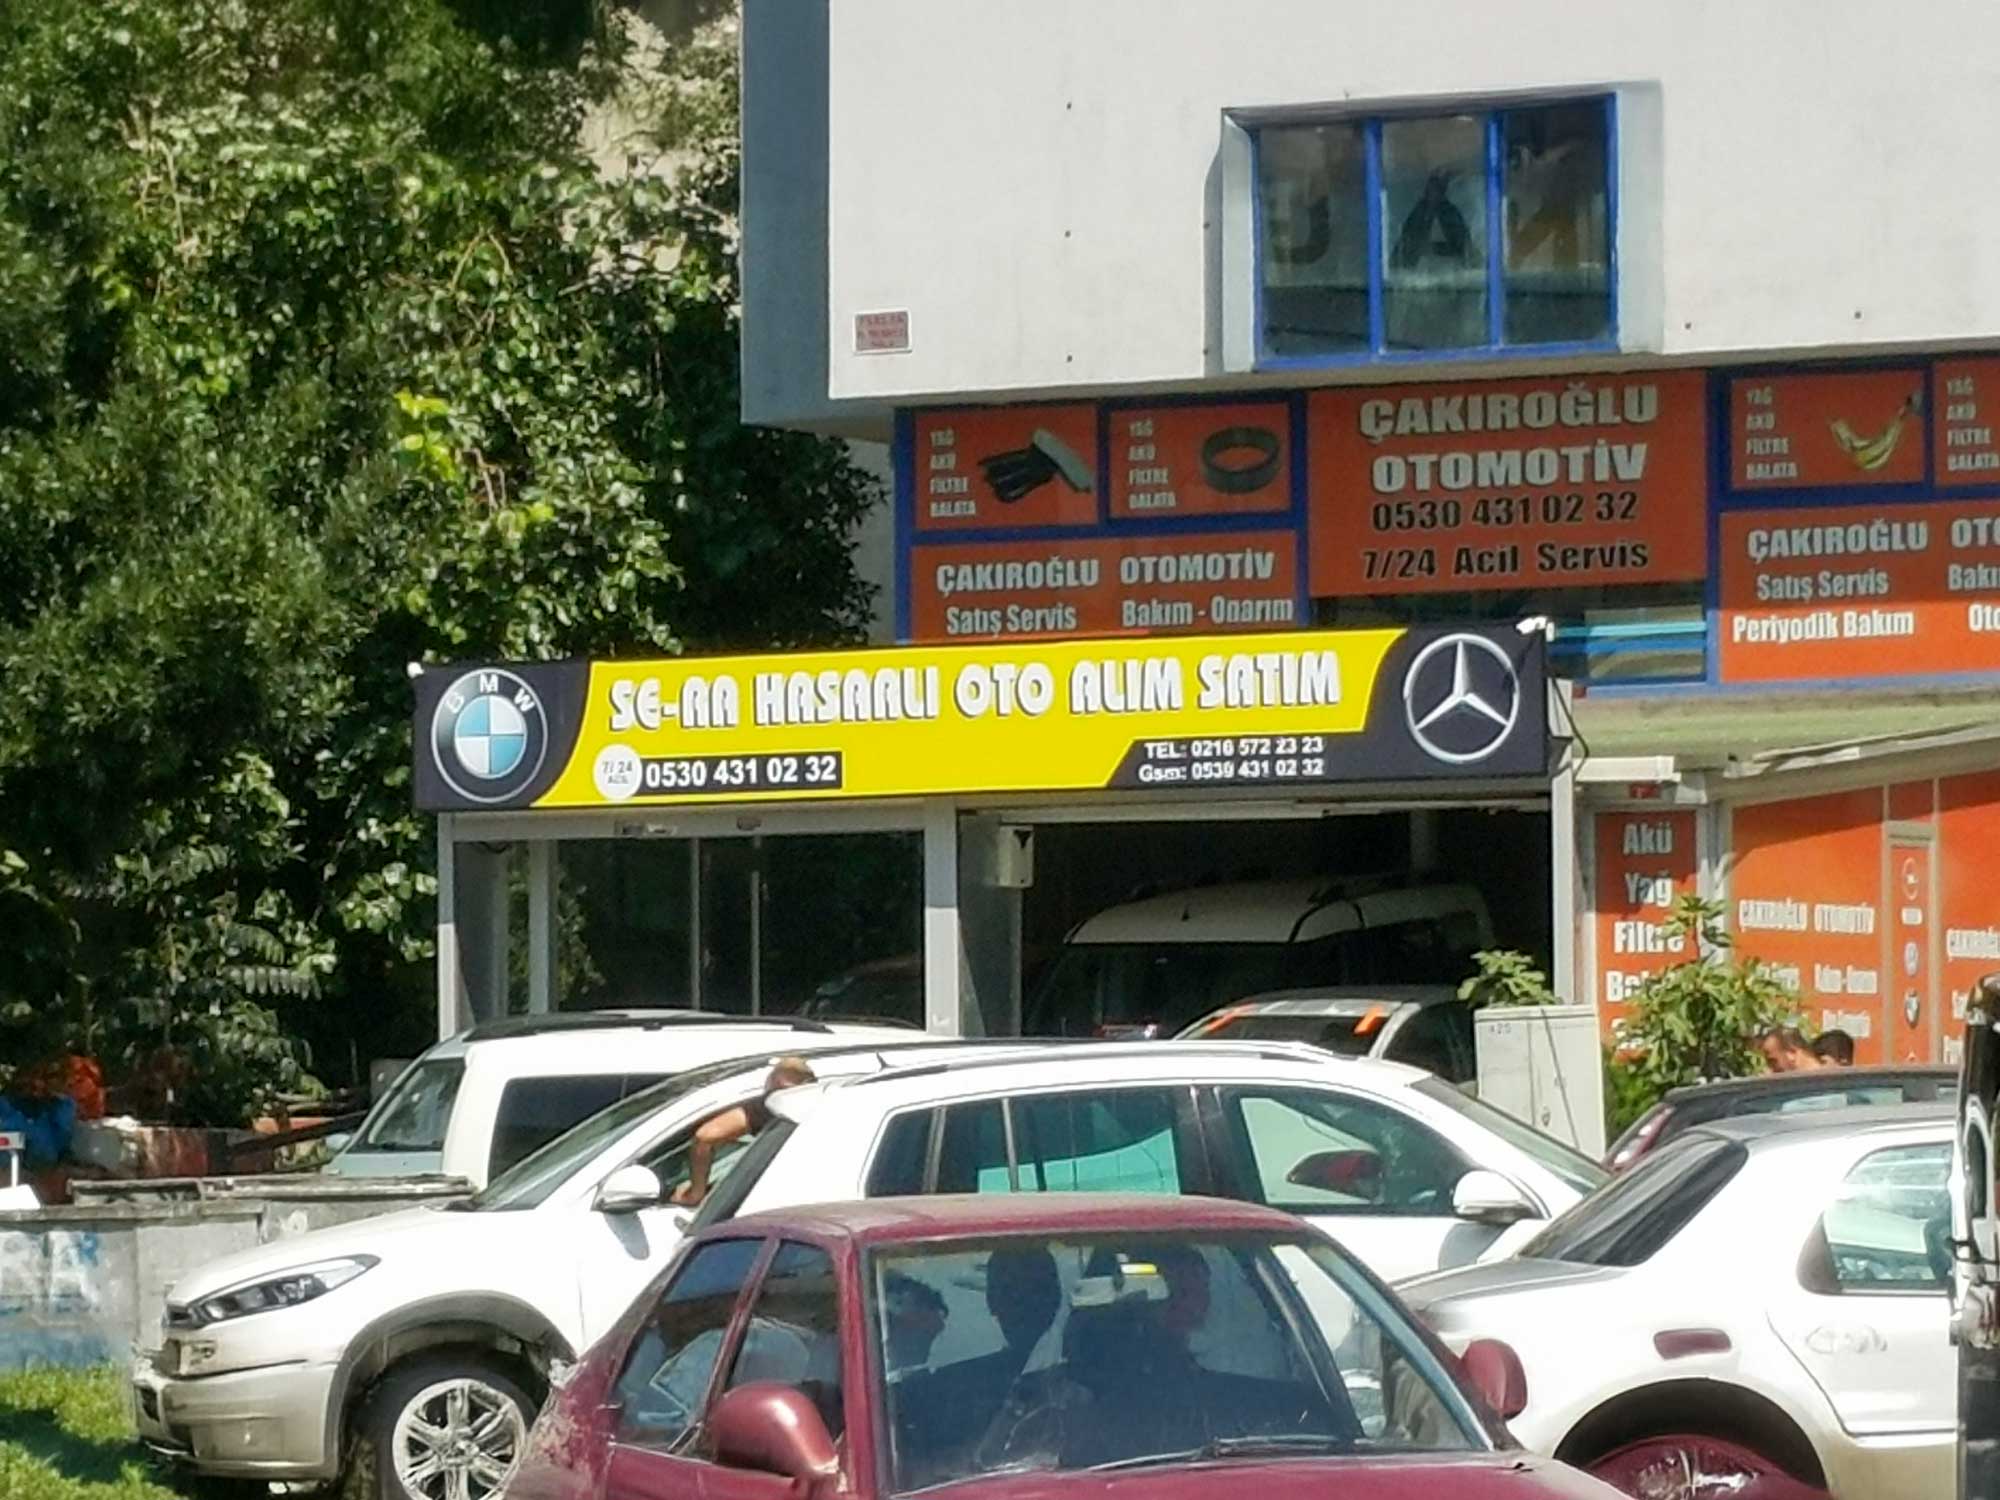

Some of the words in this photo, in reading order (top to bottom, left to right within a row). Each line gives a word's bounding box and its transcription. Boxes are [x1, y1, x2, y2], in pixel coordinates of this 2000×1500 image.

[1359, 382, 1658, 445] ÇAKIROĞLU
[1372, 438, 1647, 494] OTOMOTİV
[1373, 499, 1461, 531] 0530
[1472, 495, 1531, 527] 431
[1543, 494, 1583, 524] 02
[1596, 491, 1638, 521] 32
[1364, 549, 1436, 579] 7/24
[1454, 545, 1518, 575] Acil
[1537, 541, 1649, 572] Servis
[1748, 519, 1928, 564] ÇAKIROĞLU
[936, 556, 1100, 595] ÇAKIROĞLU
[1120, 547, 1275, 585] OTOMOTİV
[1757, 573, 1813, 603] Satış
[1818, 568, 1889, 598] Servis
[946, 605, 1001, 638] Satış
[1002, 602, 1077, 632] Servis
[1122, 598, 1192, 627] Bakım
[1211, 596, 1293, 624] Onarım
[1733, 612, 1839, 644] Periyodik
[1842, 609, 1915, 638] Bakım
[953, 662, 1055, 719] OTO
[1069, 656, 1184, 714] ALIM
[1197, 650, 1341, 709] SATIM
[1238, 737, 1272, 756] 572
[1275, 737, 1298, 755] 23
[1302, 736, 1324, 754] 23
[645, 760, 707, 788] 0530
[712, 758, 758, 786] 431
[767, 758, 799, 783] 02
[805, 756, 837, 782] 32
[1237, 760, 1270, 778] 431
[1275, 759, 1298, 777] 02
[1302, 758, 1325, 775] 32
[1623, 822, 1672, 855] Akü
[1624, 870, 1673, 908] Yağ
